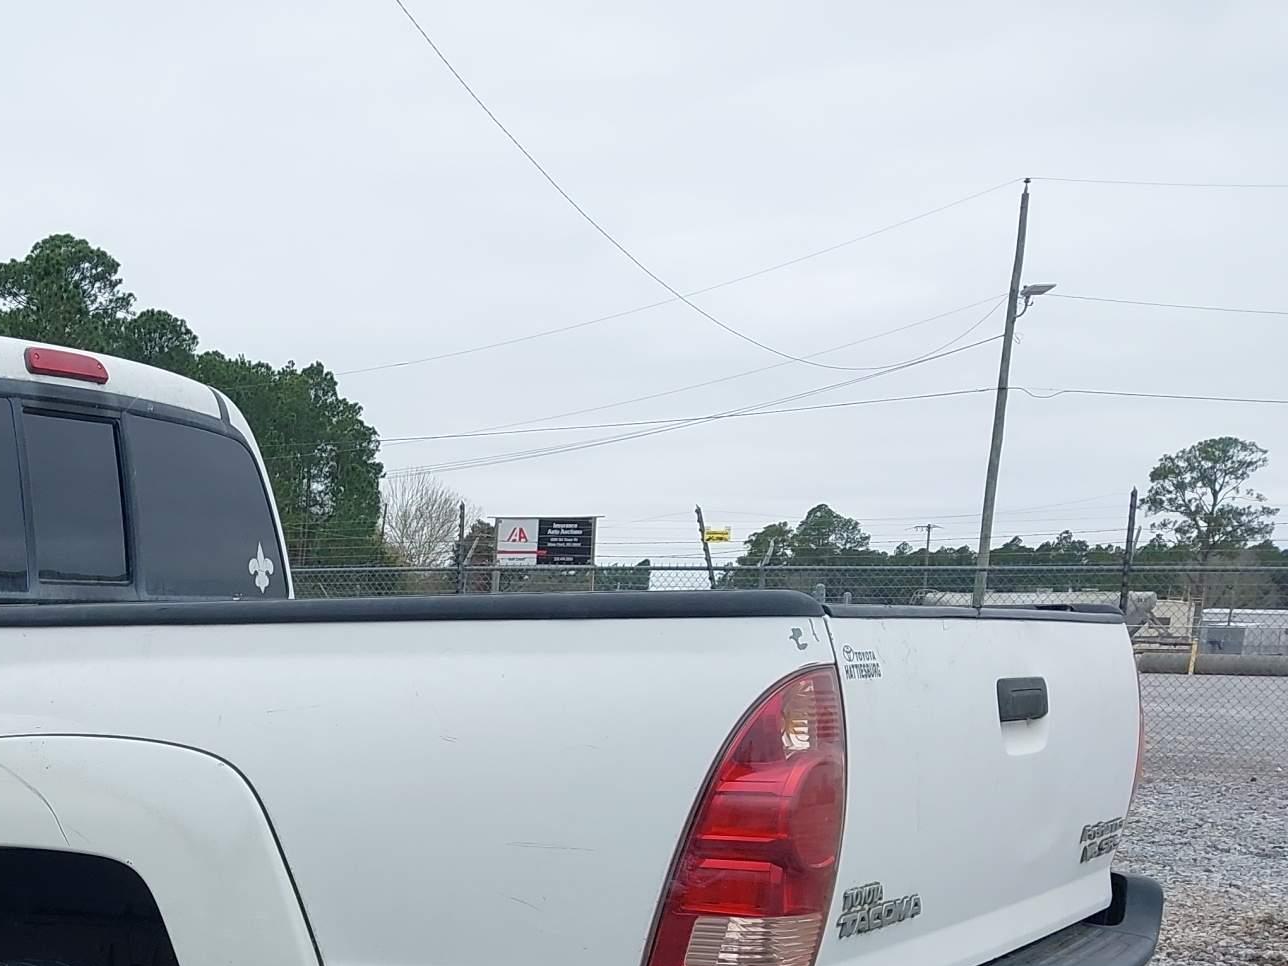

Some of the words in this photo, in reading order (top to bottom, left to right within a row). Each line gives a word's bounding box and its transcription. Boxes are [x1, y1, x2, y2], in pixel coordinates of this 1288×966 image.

[854, 651, 877, 662] TOYOTA
[844, 662, 882, 680] HATTIESBURG
[836, 893, 922, 939] TACOMA
